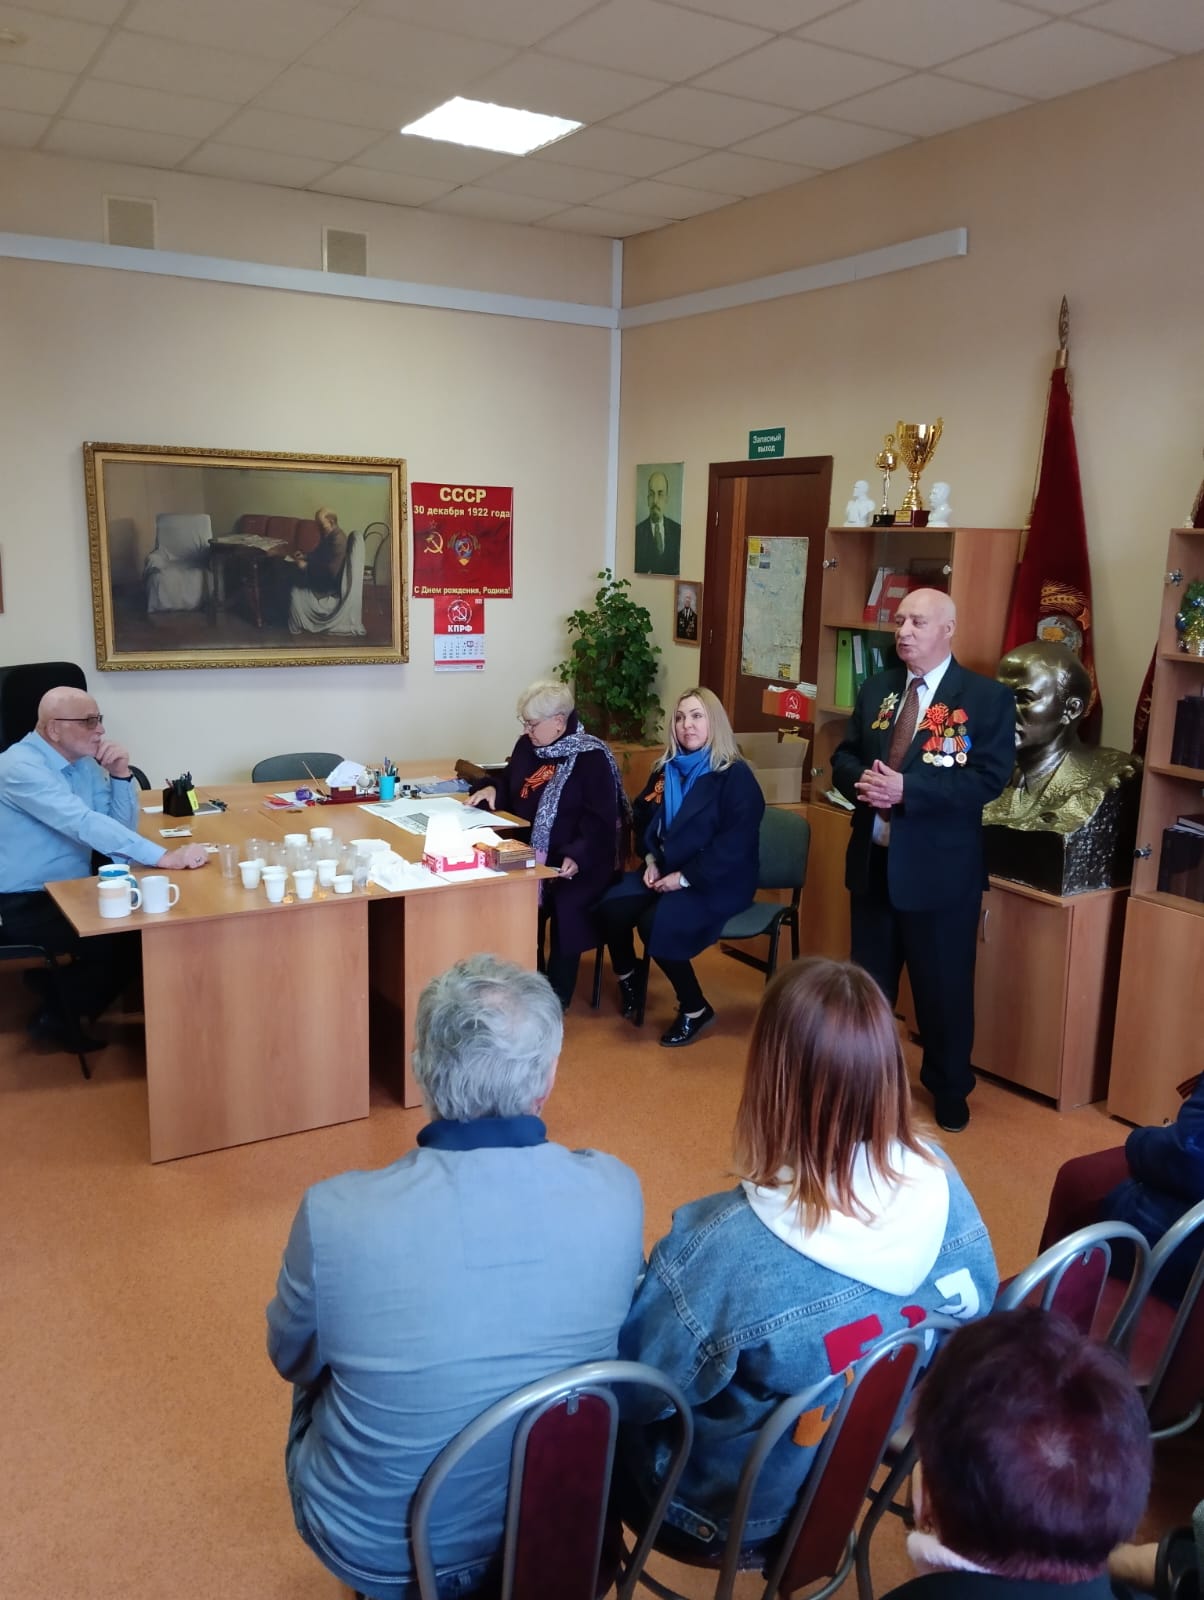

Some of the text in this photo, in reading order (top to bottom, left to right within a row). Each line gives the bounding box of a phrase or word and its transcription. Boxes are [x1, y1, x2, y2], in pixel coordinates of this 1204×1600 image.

[752, 433, 782, 444] Запасный
[757, 445, 776, 454] выход
[439, 487, 487, 503] СССР
[413, 505, 511, 519] 30 декабря 1922 года
[414, 586, 420, 594] С
[447, 624, 473, 633] КПРФ
